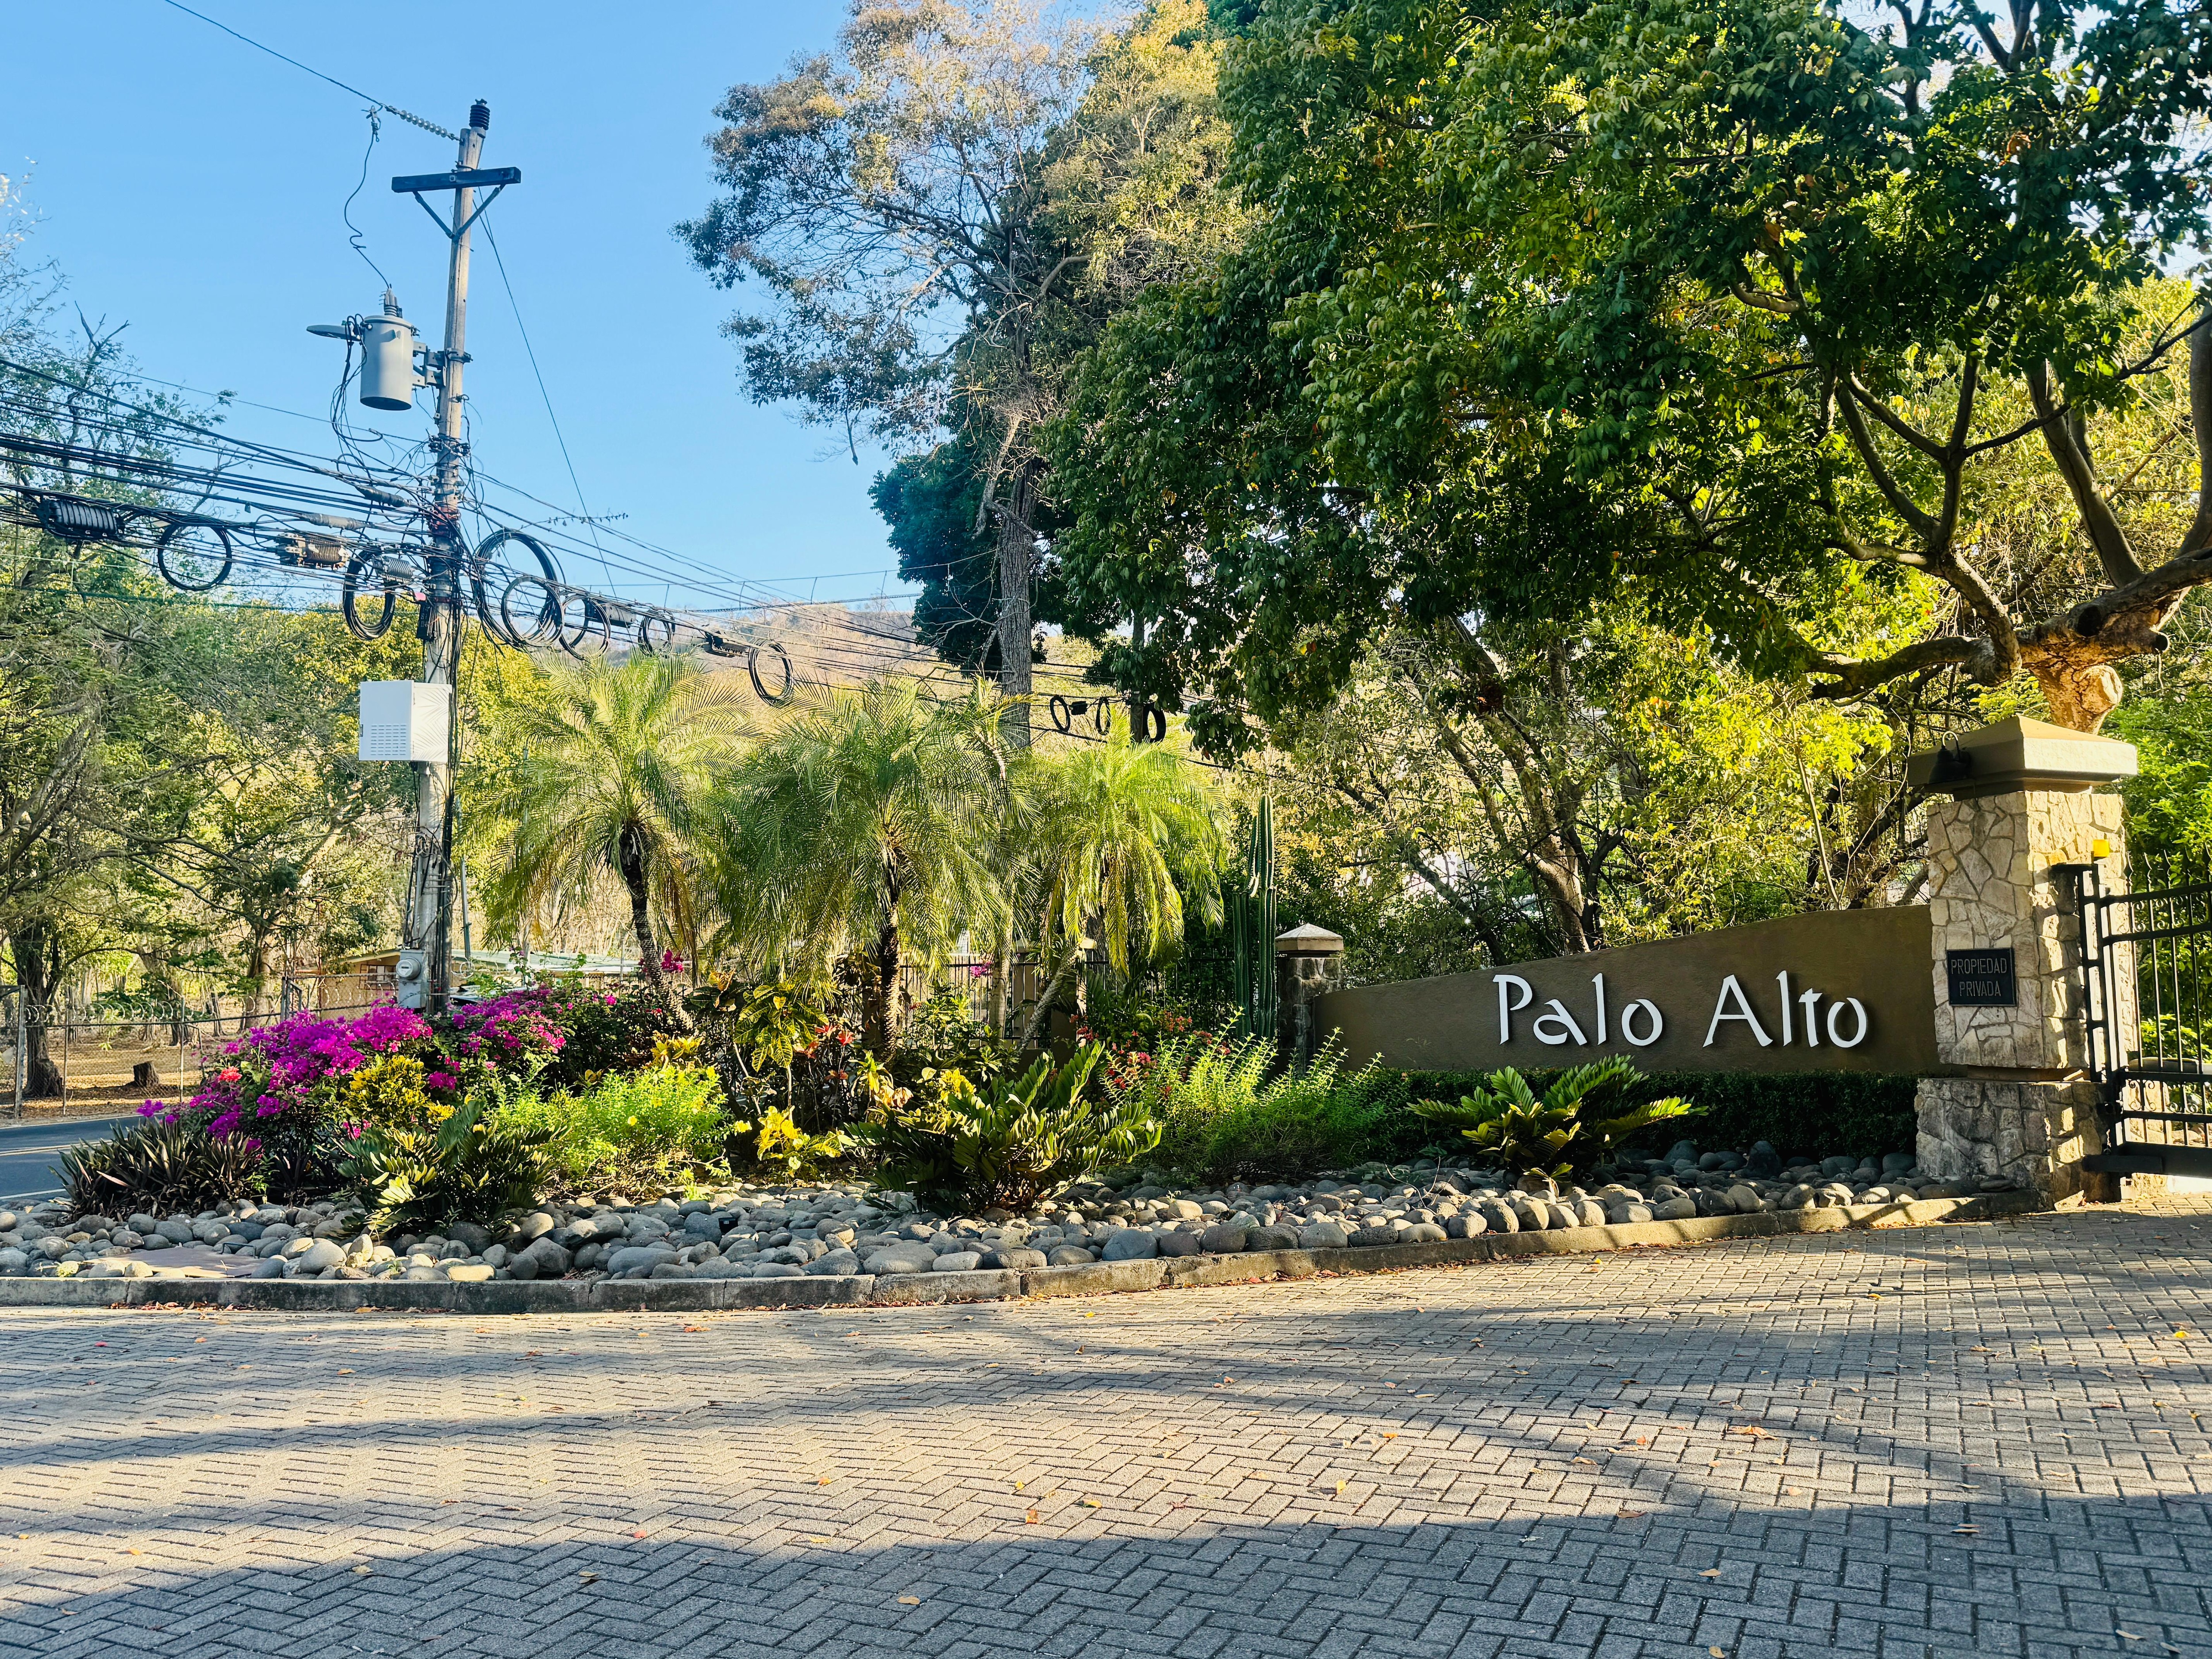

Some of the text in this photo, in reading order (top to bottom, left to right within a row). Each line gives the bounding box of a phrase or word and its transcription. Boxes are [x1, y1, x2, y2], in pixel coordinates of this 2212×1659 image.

[1951, 958, 2007, 974] PROPIEDAD
[1959, 981, 2001, 996] PRIVADA
[1492, 970, 1867, 1048] Palo Alto
